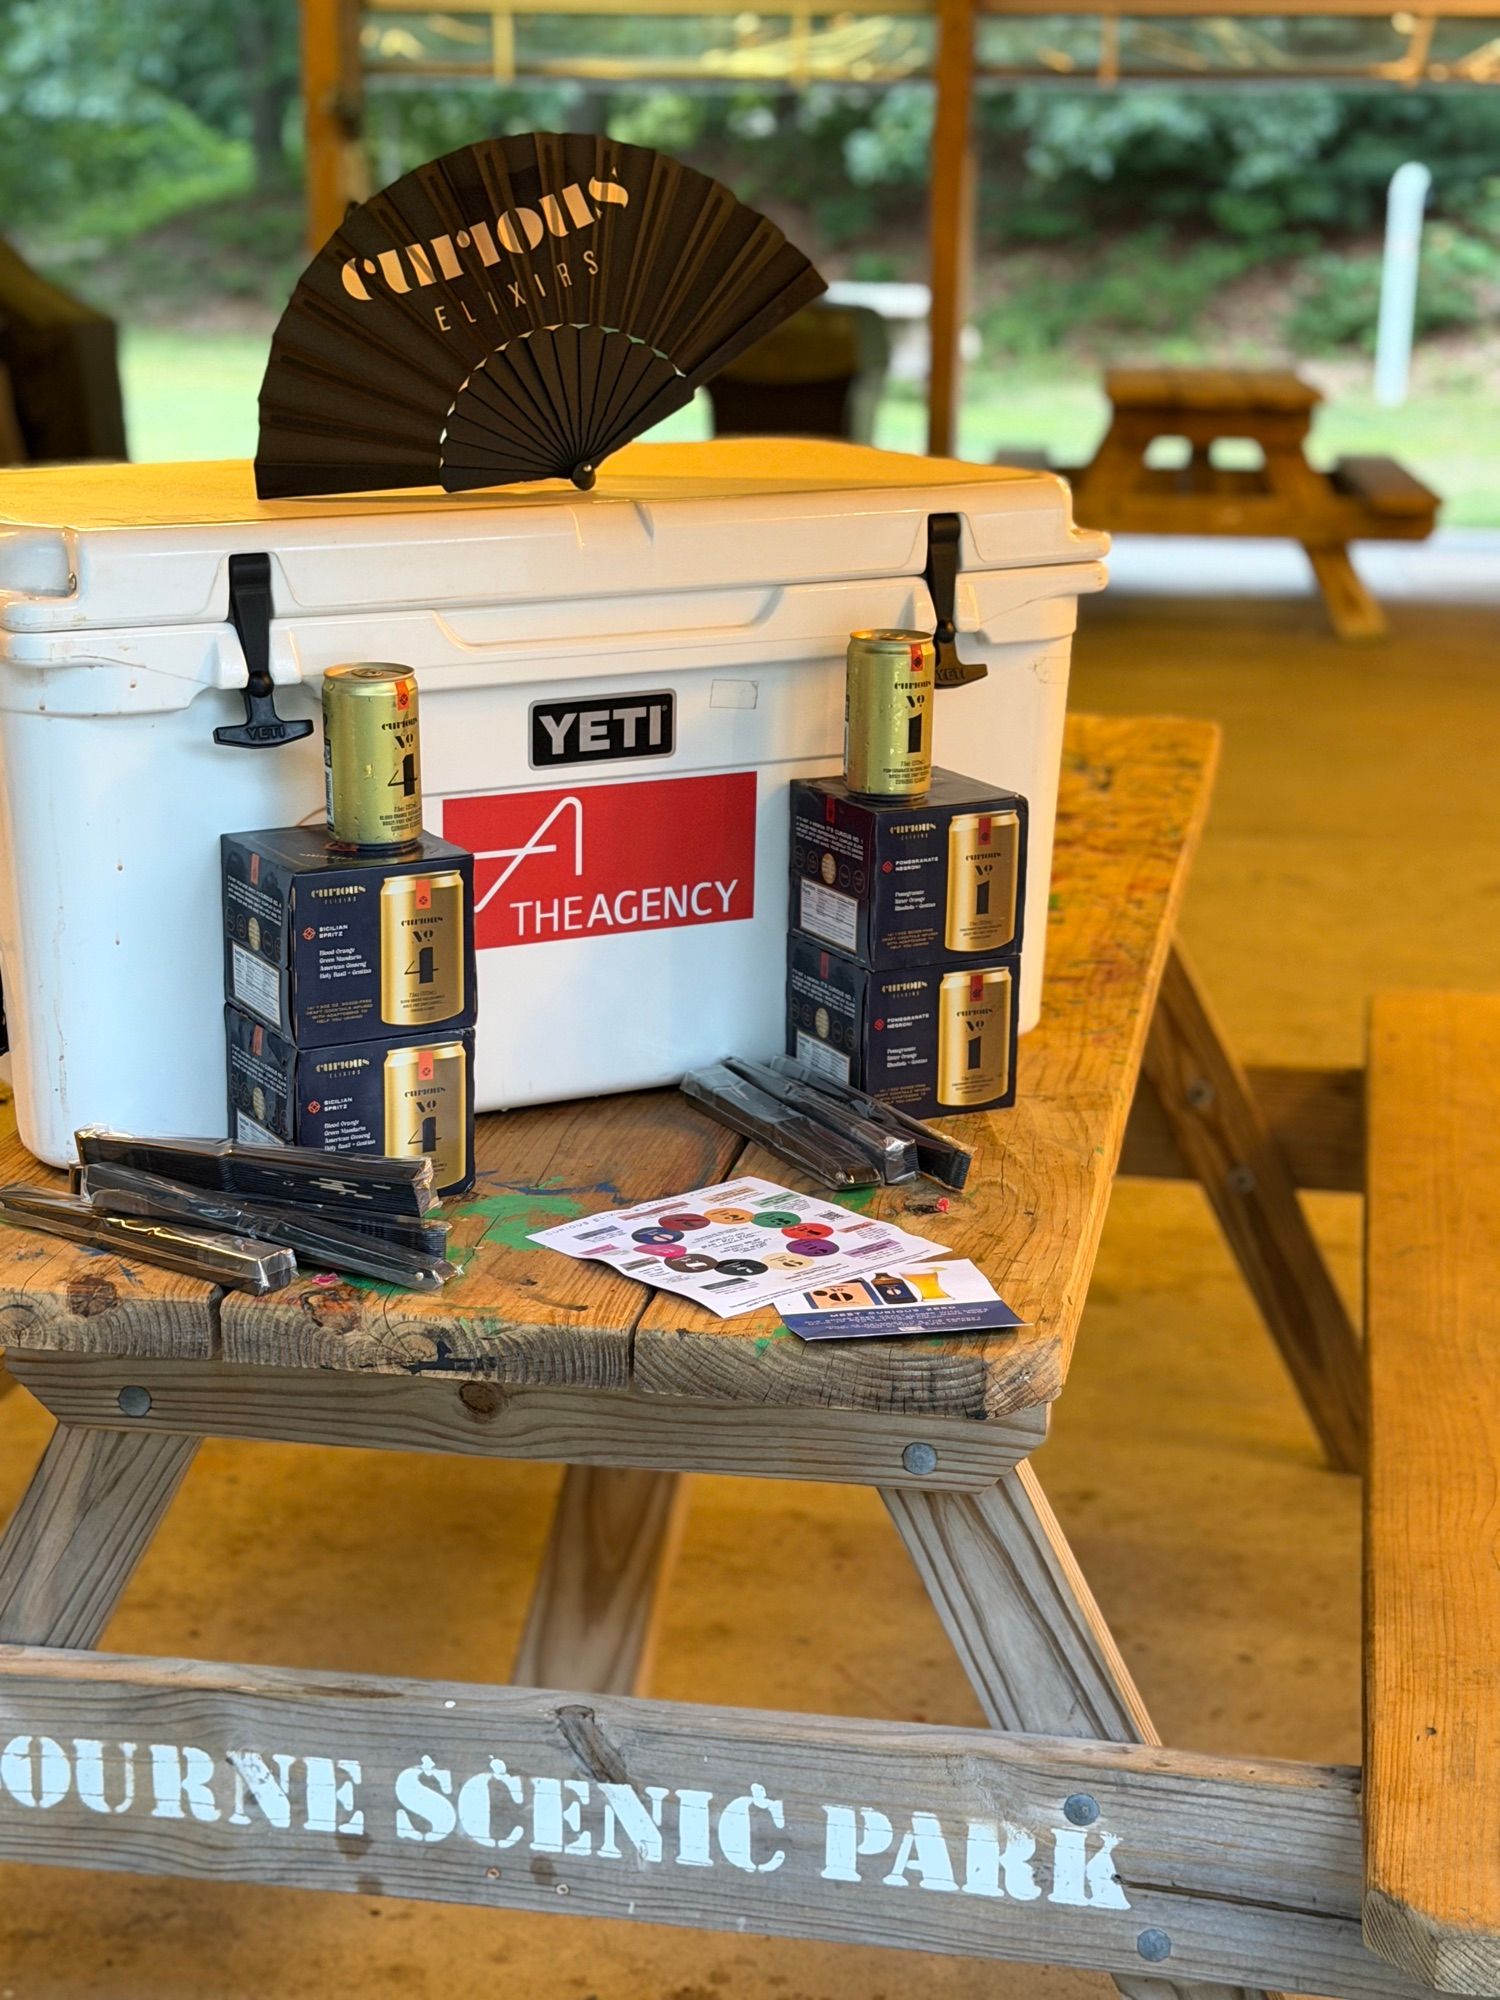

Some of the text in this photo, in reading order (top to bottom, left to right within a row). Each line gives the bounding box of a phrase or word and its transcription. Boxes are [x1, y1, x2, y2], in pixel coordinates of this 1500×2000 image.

[341, 168, 629, 301] curious
[434, 251, 600, 332] ELIXIRS
[246, 725, 287, 742] YETI
[538, 705, 662, 756] YETI
[907, 712, 922, 754] 1
[387, 753, 418, 797] 4
[319, 924, 349, 933] SICILIAN
[319, 931, 344, 939] SPRITZ
[404, 947, 440, 984] 4
[324, 1097, 353, 1106] SICILIAN
[324, 1104, 348, 1112] SPRITZ
[408, 1116, 442, 1154] 4
[0, 1735, 1132, 1911] OURNE SCENIC PARK
